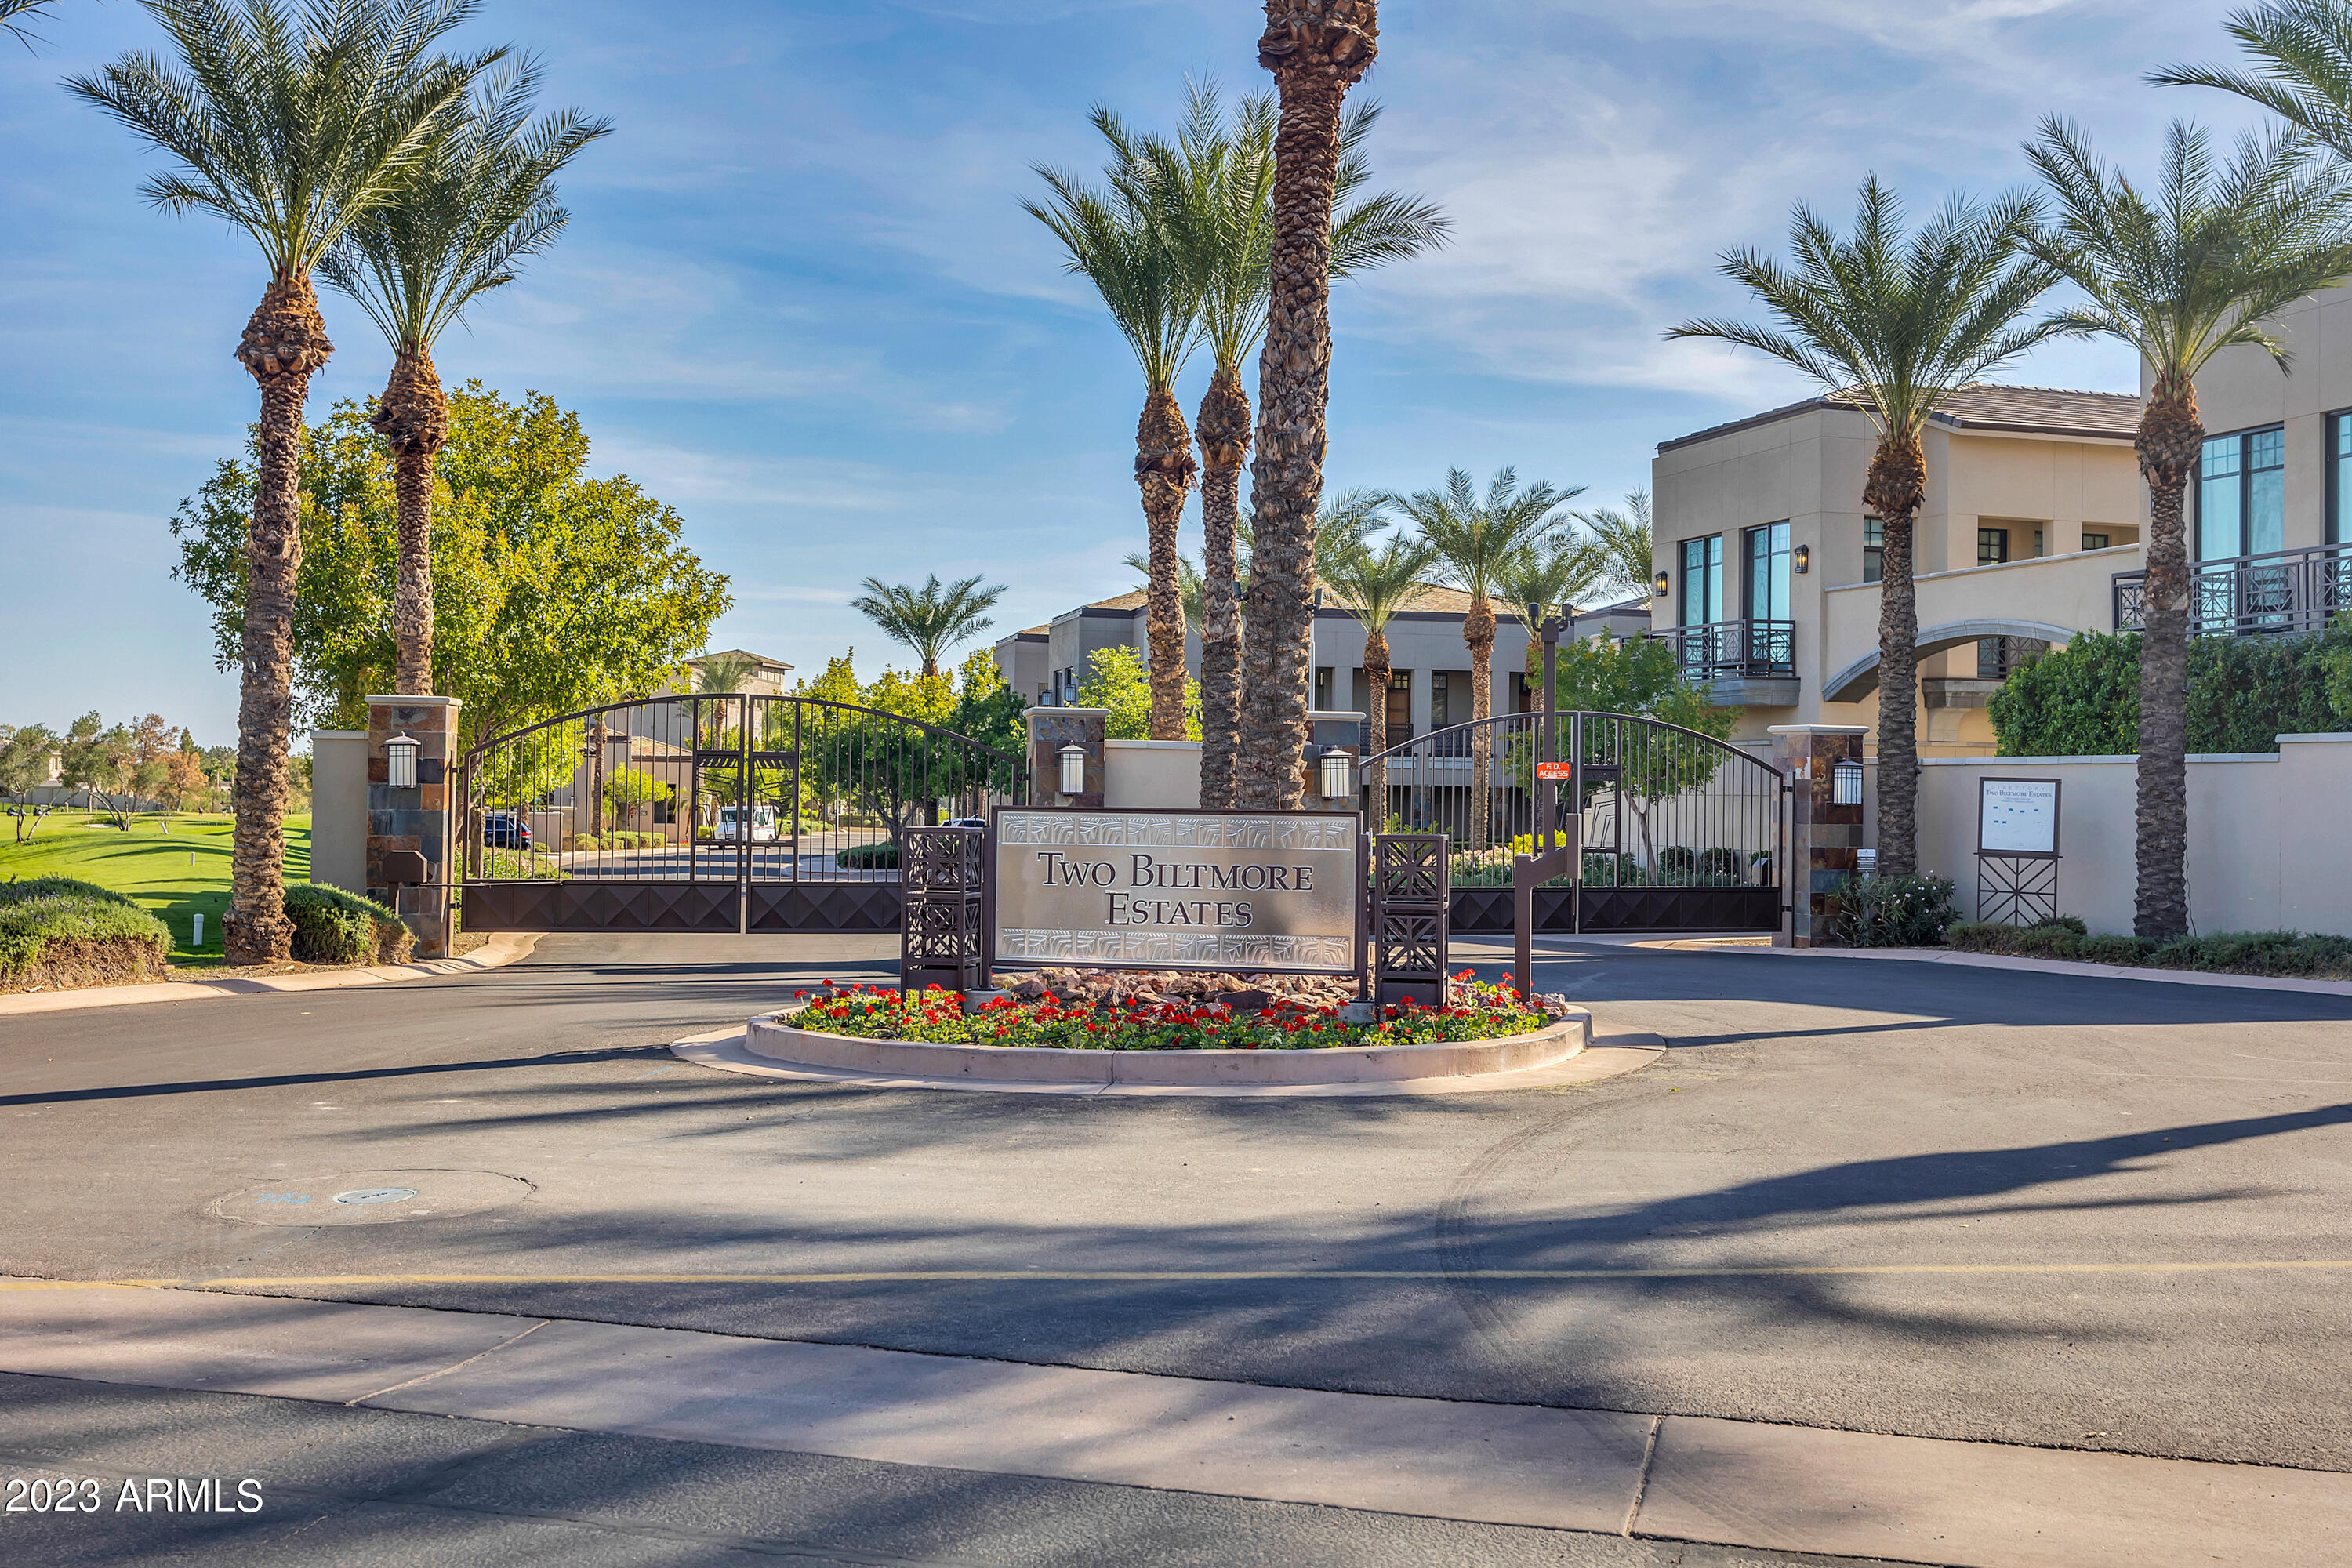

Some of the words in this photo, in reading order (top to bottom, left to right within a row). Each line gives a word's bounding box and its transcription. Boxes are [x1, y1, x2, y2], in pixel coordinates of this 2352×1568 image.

[1037, 852, 1116, 887] TWO
[1130, 854, 1314, 891] BILTMORE
[1105, 891, 1253, 927] ESTATES
